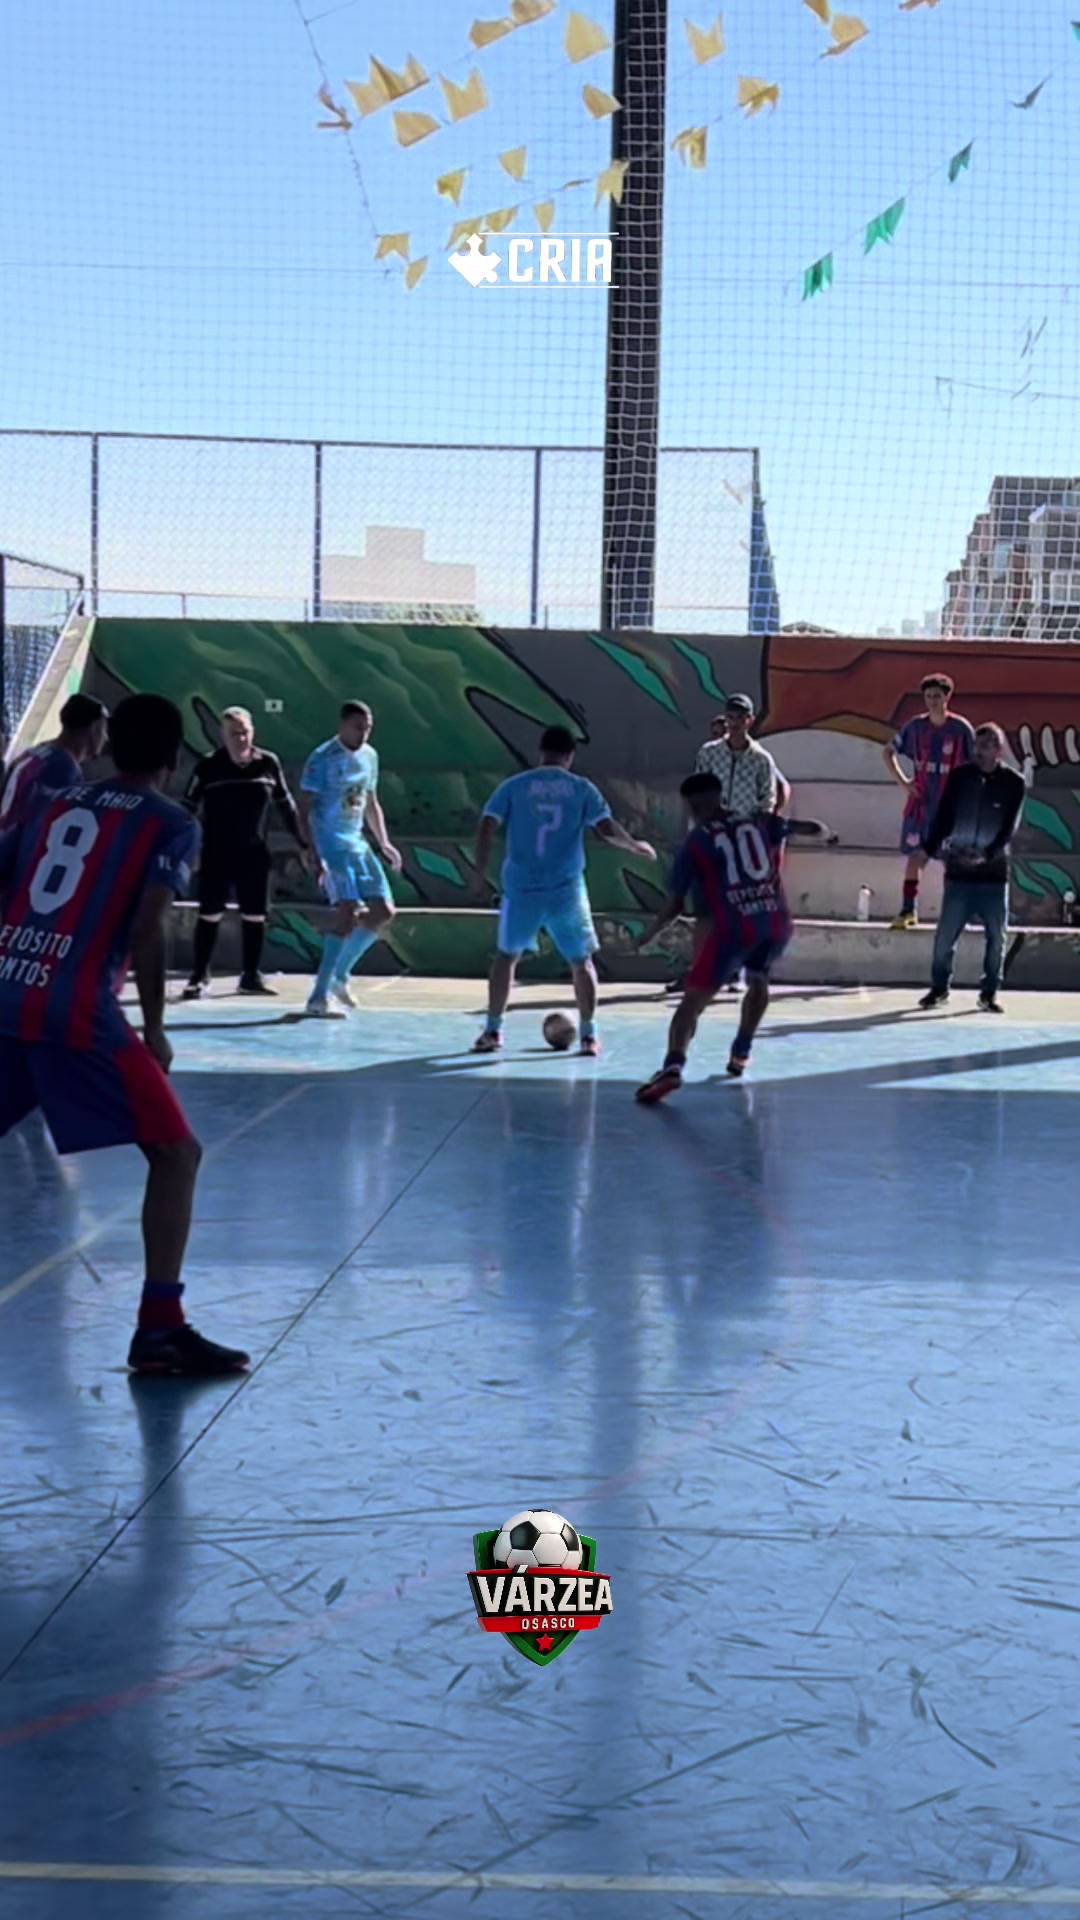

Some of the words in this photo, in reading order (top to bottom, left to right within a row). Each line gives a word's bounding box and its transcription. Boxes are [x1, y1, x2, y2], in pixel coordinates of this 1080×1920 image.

[95, 790, 144, 809] MAIO
[536, 803, 562, 856] 7
[715, 824, 769, 885] 10
[29, 807, 99, 915] 8
